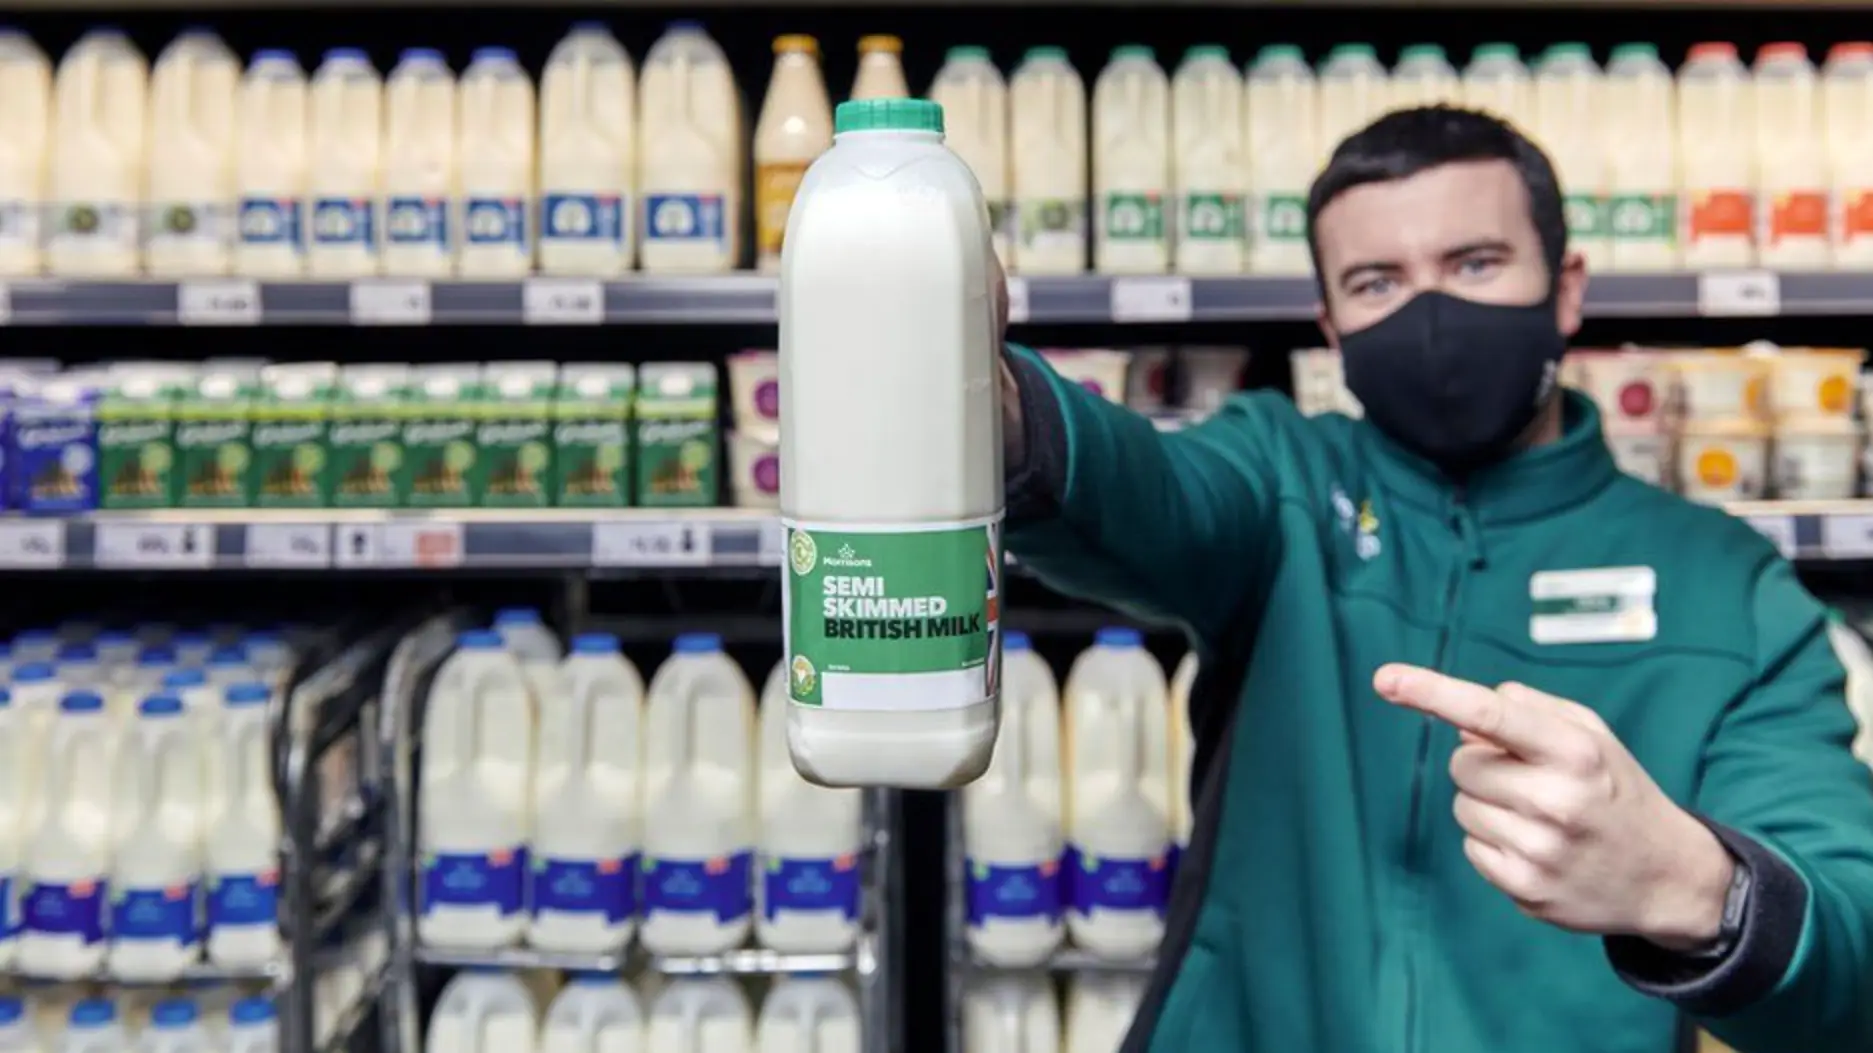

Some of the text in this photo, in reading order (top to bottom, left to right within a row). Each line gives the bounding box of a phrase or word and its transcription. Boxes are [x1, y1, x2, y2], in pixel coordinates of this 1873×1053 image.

[823, 556, 872, 567] Morrisons
[823, 576, 884, 597] SEMI
[823, 596, 948, 618] SKIMMED
[824, 613, 980, 640] BRITISH MILK
